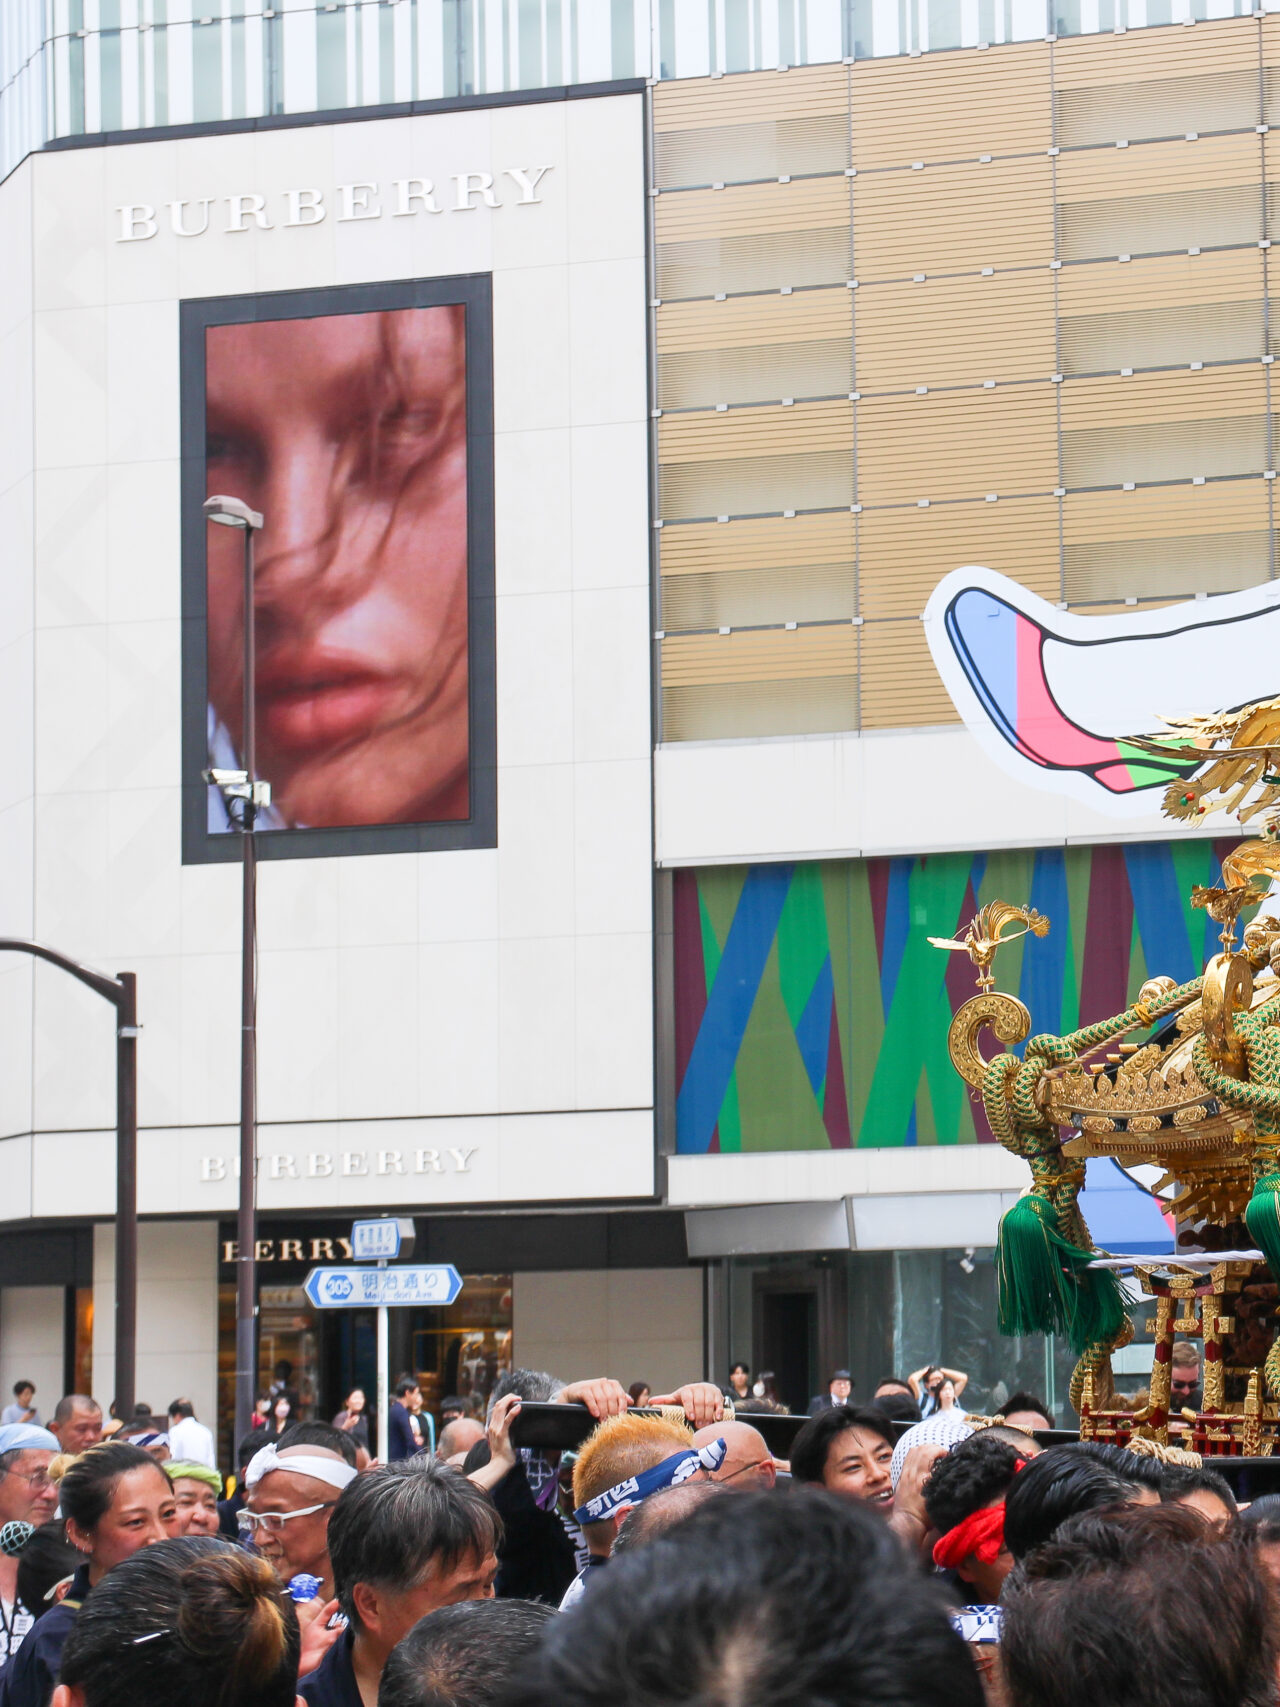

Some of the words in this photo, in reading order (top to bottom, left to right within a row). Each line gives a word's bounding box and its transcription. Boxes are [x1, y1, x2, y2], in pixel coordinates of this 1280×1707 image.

[115, 164, 555, 243] BURBERRY
[326, 1279, 351, 1296] 305
[362, 1272, 438, 1290] 明治通り
